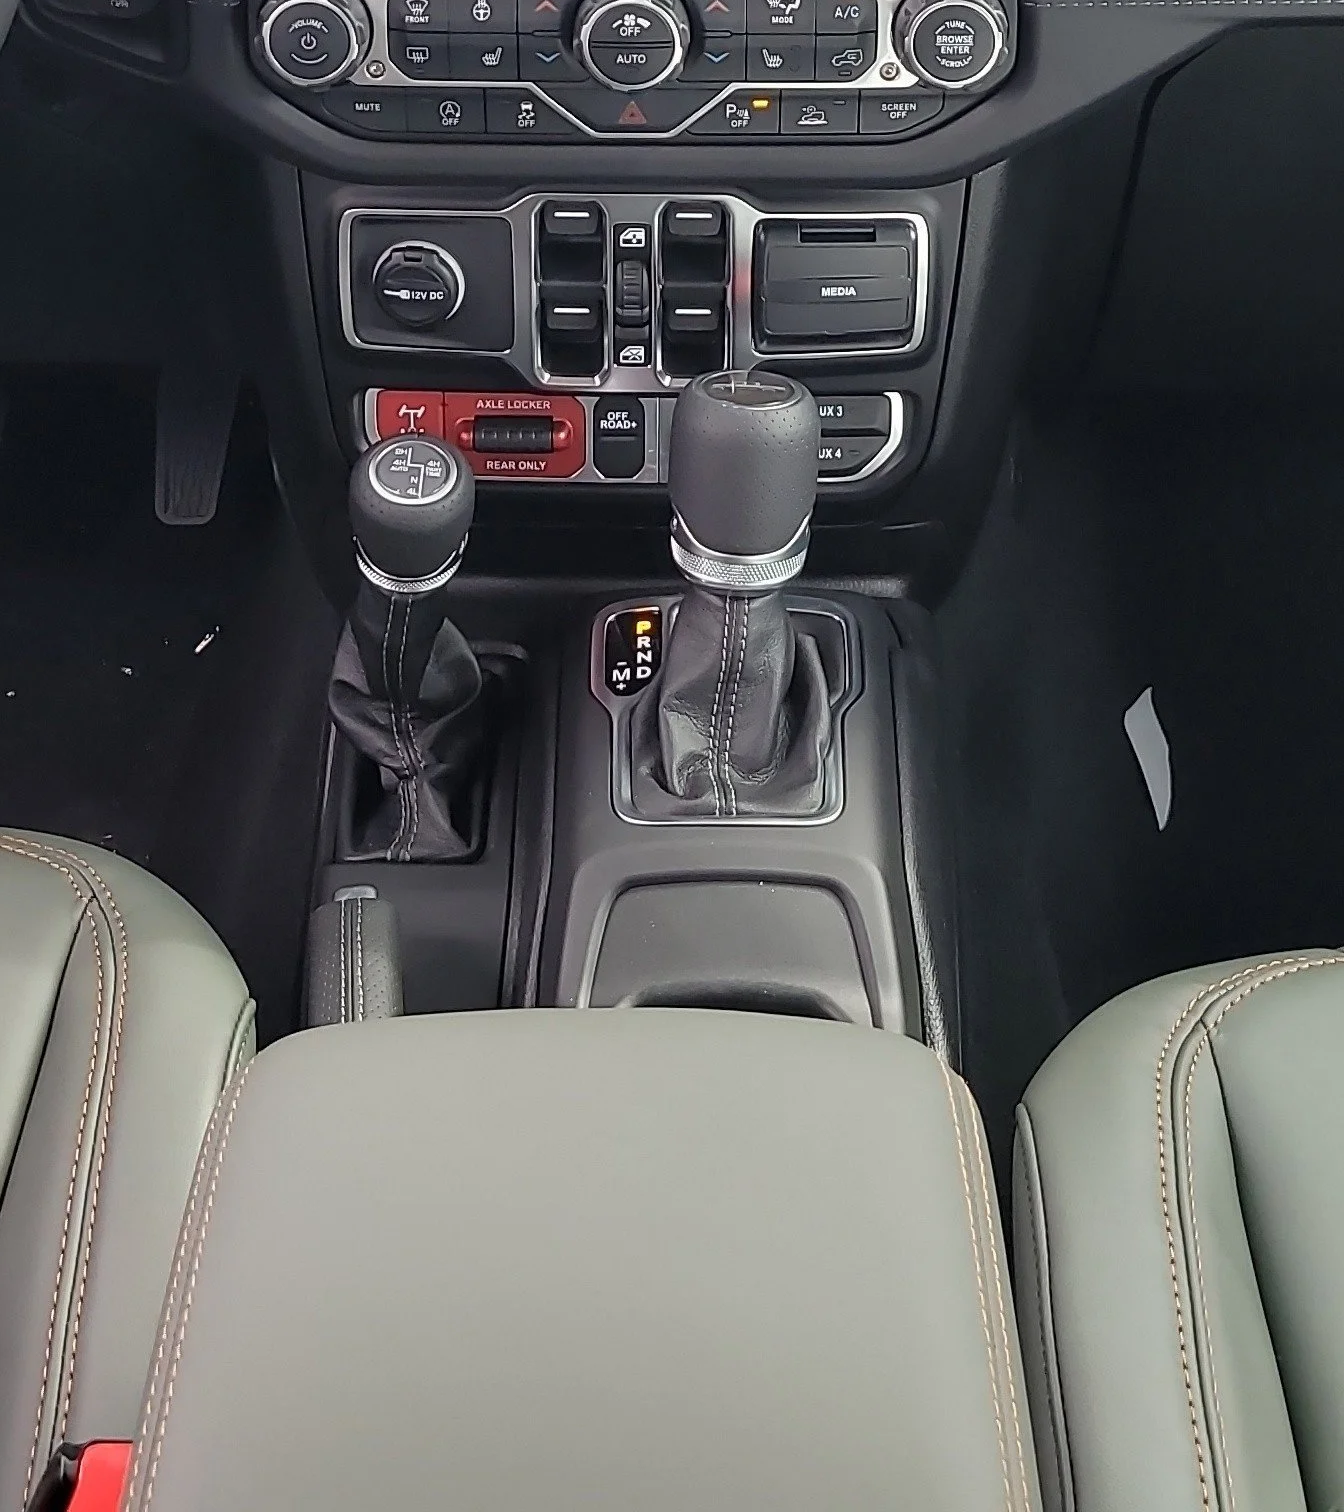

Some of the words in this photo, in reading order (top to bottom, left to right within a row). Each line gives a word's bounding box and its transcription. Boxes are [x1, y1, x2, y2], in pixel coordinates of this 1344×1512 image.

[834, 6, 860, 19] A/C
[292, 18, 324, 30] VOLUME
[405, 15, 430, 24] FRONT
[771, 16, 794, 25] MODE
[944, 20, 966, 30] TUNE
[619, 27, 641, 37] OFF
[936, 34, 974, 44] BROWSE
[940, 45, 970, 55] ENTER
[616, 54, 646, 64] AUTO
[938, 56, 972, 69] SCROLL
[355, 102, 381, 112] MUTE
[881, 102, 917, 112] SCREEN
[889, 111, 908, 120] OFF
[441, 117, 460, 127] OFF
[517, 119, 535, 128] OFF
[730, 119, 749, 129] OFF
[410, 291, 427, 301] 12V
[429, 291, 444, 301] DC
[821, 285, 857, 298] MEDIA
[476, 399, 505, 410] AXLE
[507, 399, 551, 410] LOCKER
[606, 411, 629, 421] OFF
[837, 406, 843, 417] 3
[600, 419, 638, 430] ROAD+
[834, 448, 842, 459] 4
[427, 460, 440, 468] 4H
[486, 460, 515, 471] REAR
[518, 461, 546, 472] ONLY
[410, 476, 418, 484] N
[637, 621, 651, 635] P
[637, 636, 651, 649] R
[637, 650, 652, 663] N
[612, 668, 630, 681] M
[637, 666, 652, 679] D
